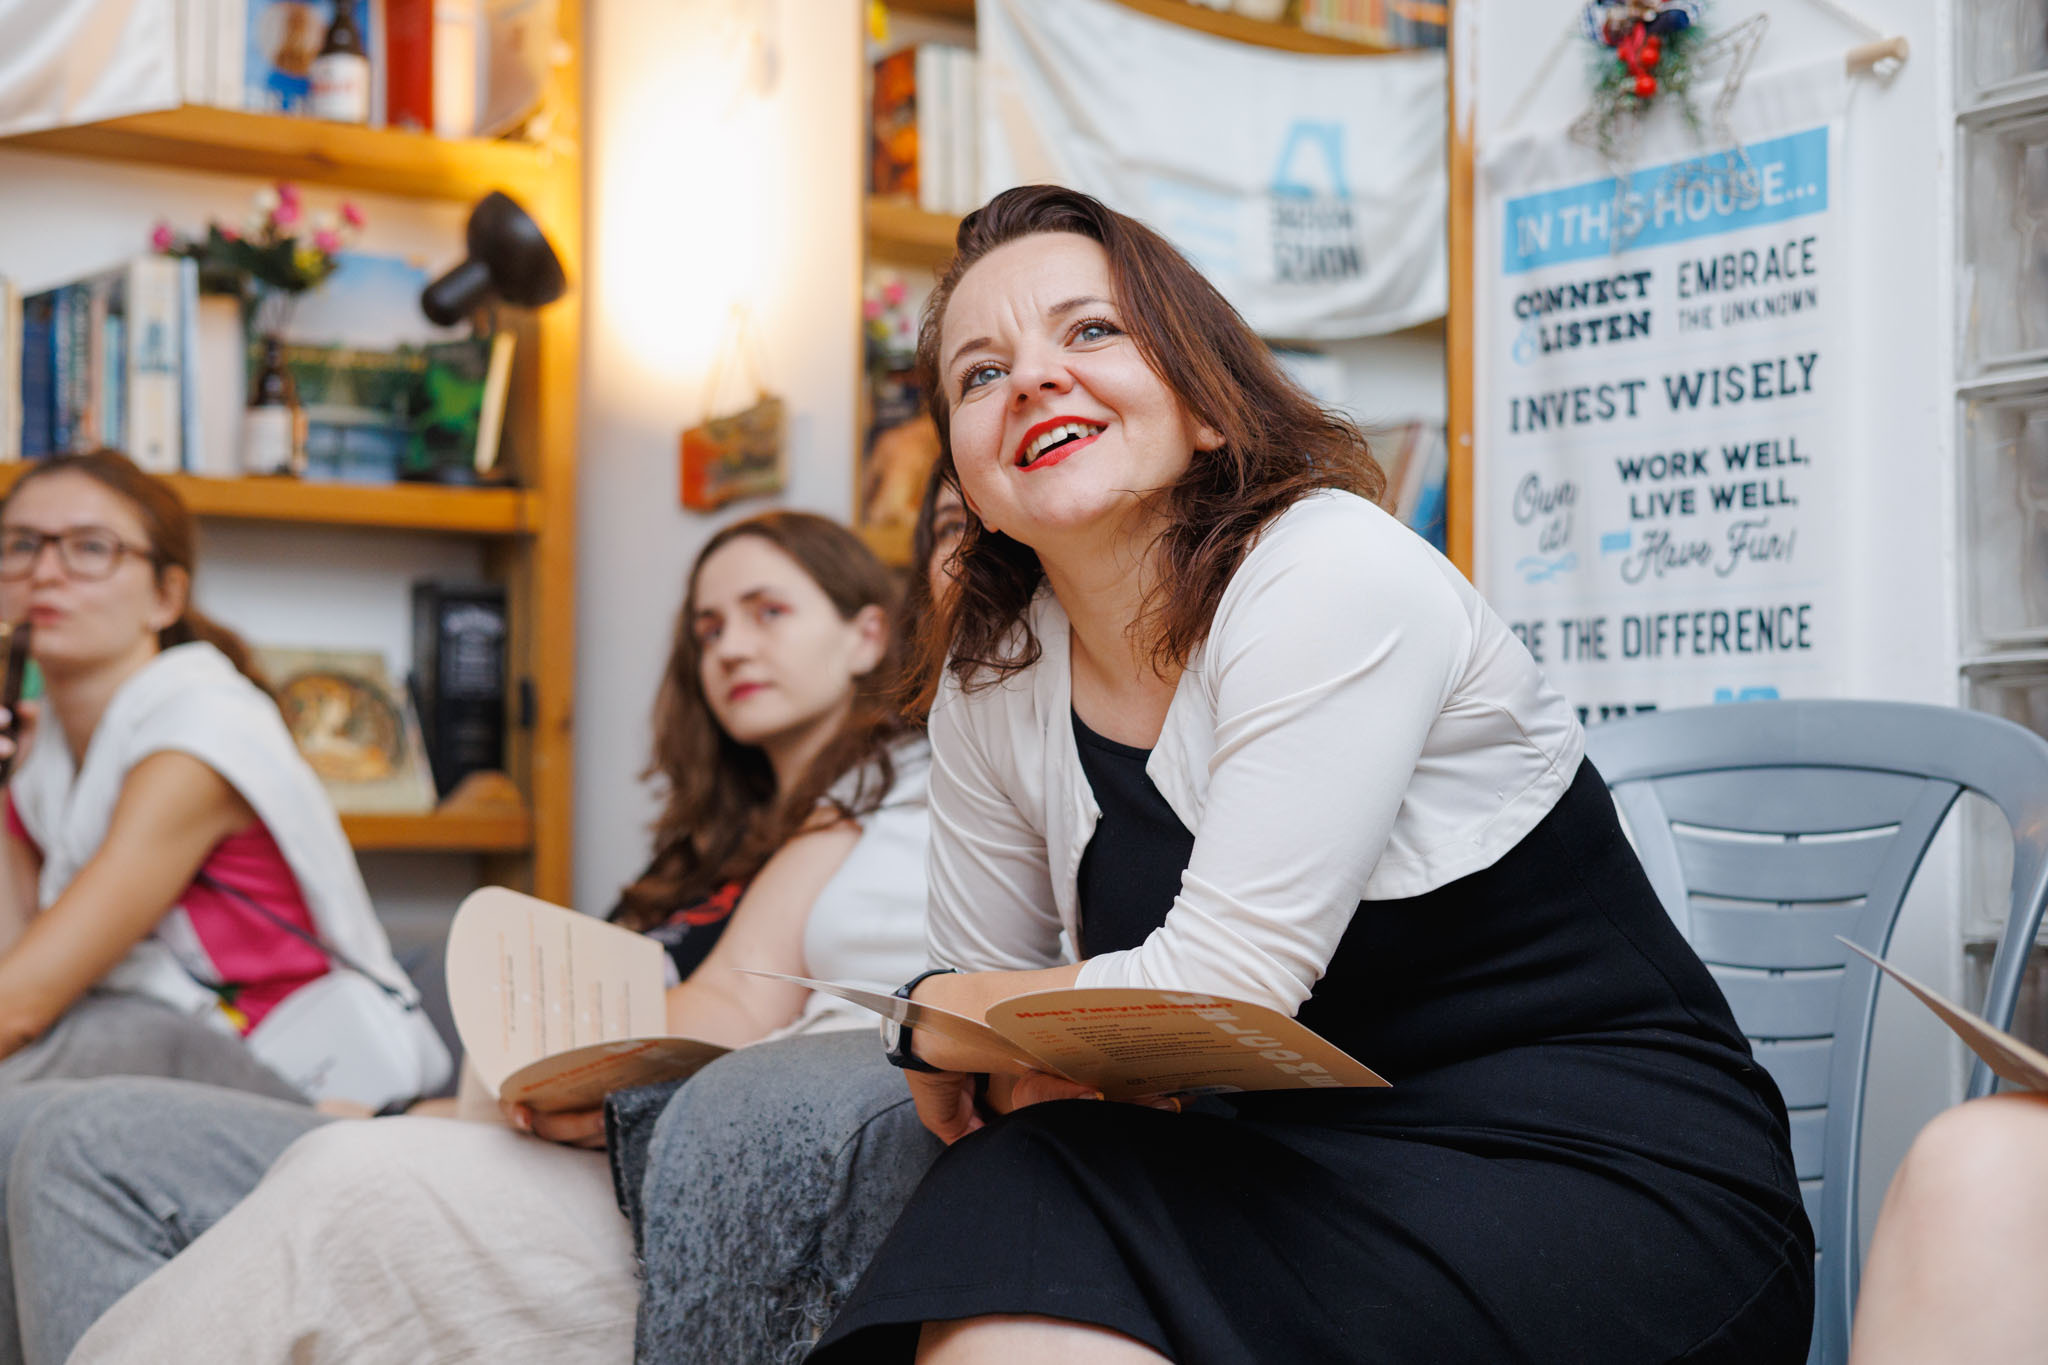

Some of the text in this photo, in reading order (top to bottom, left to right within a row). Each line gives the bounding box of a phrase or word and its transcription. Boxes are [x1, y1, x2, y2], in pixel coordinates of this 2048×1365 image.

[1517, 162, 1817, 256] IN THIS HOUSE...
[1514, 271, 1653, 320] CONNECT
[1677, 236, 1817, 299] EMBRACE
[1540, 311, 1652, 353] LISTEN
[1678, 287, 1818, 332] THE UNKNOWN
[1510, 353, 1819, 433] INVEST WISELY
[1616, 449, 1709, 482] WORK
[1512, 471, 1577, 526] Own
[1630, 488, 1697, 520] LIVE
[1620, 529, 1713, 584] Have
[1714, 515, 1797, 579] Fun!
[1559, 617, 1608, 664] THE
[1622, 603, 1813, 659] DIFFERENCE
[1160, 993, 1345, 1088] WELCOME
